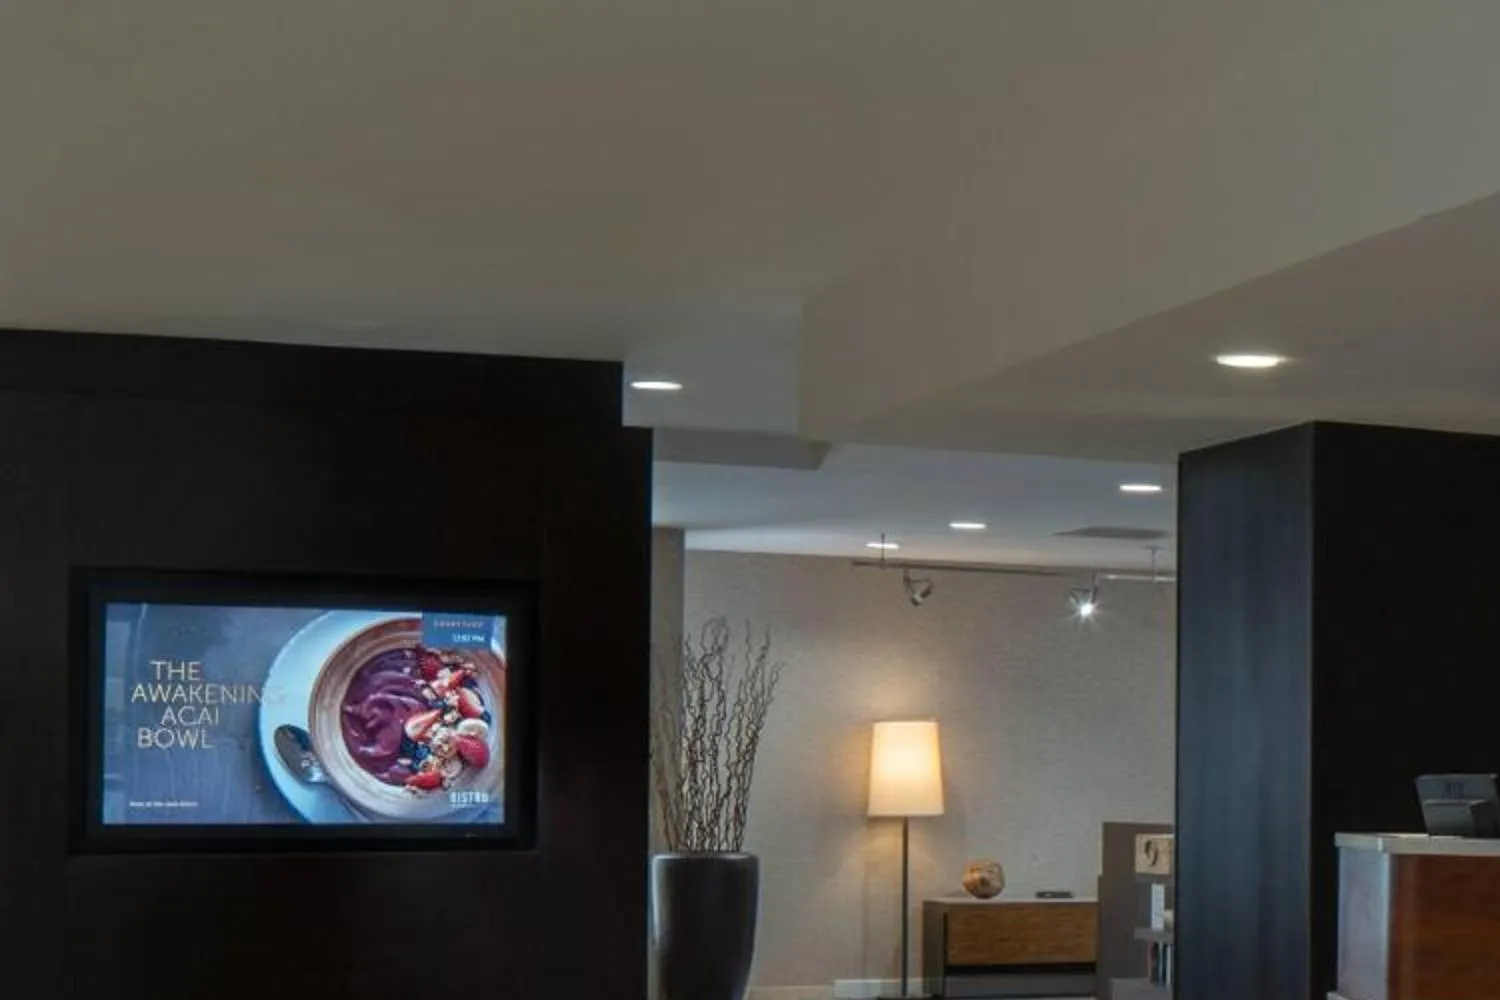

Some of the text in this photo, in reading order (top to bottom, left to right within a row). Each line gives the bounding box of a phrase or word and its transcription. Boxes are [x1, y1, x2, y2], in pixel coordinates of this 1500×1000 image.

[150, 659, 204, 681] THE
[160, 704, 220, 727] ACAI
[137, 726, 216, 749] BOWL
